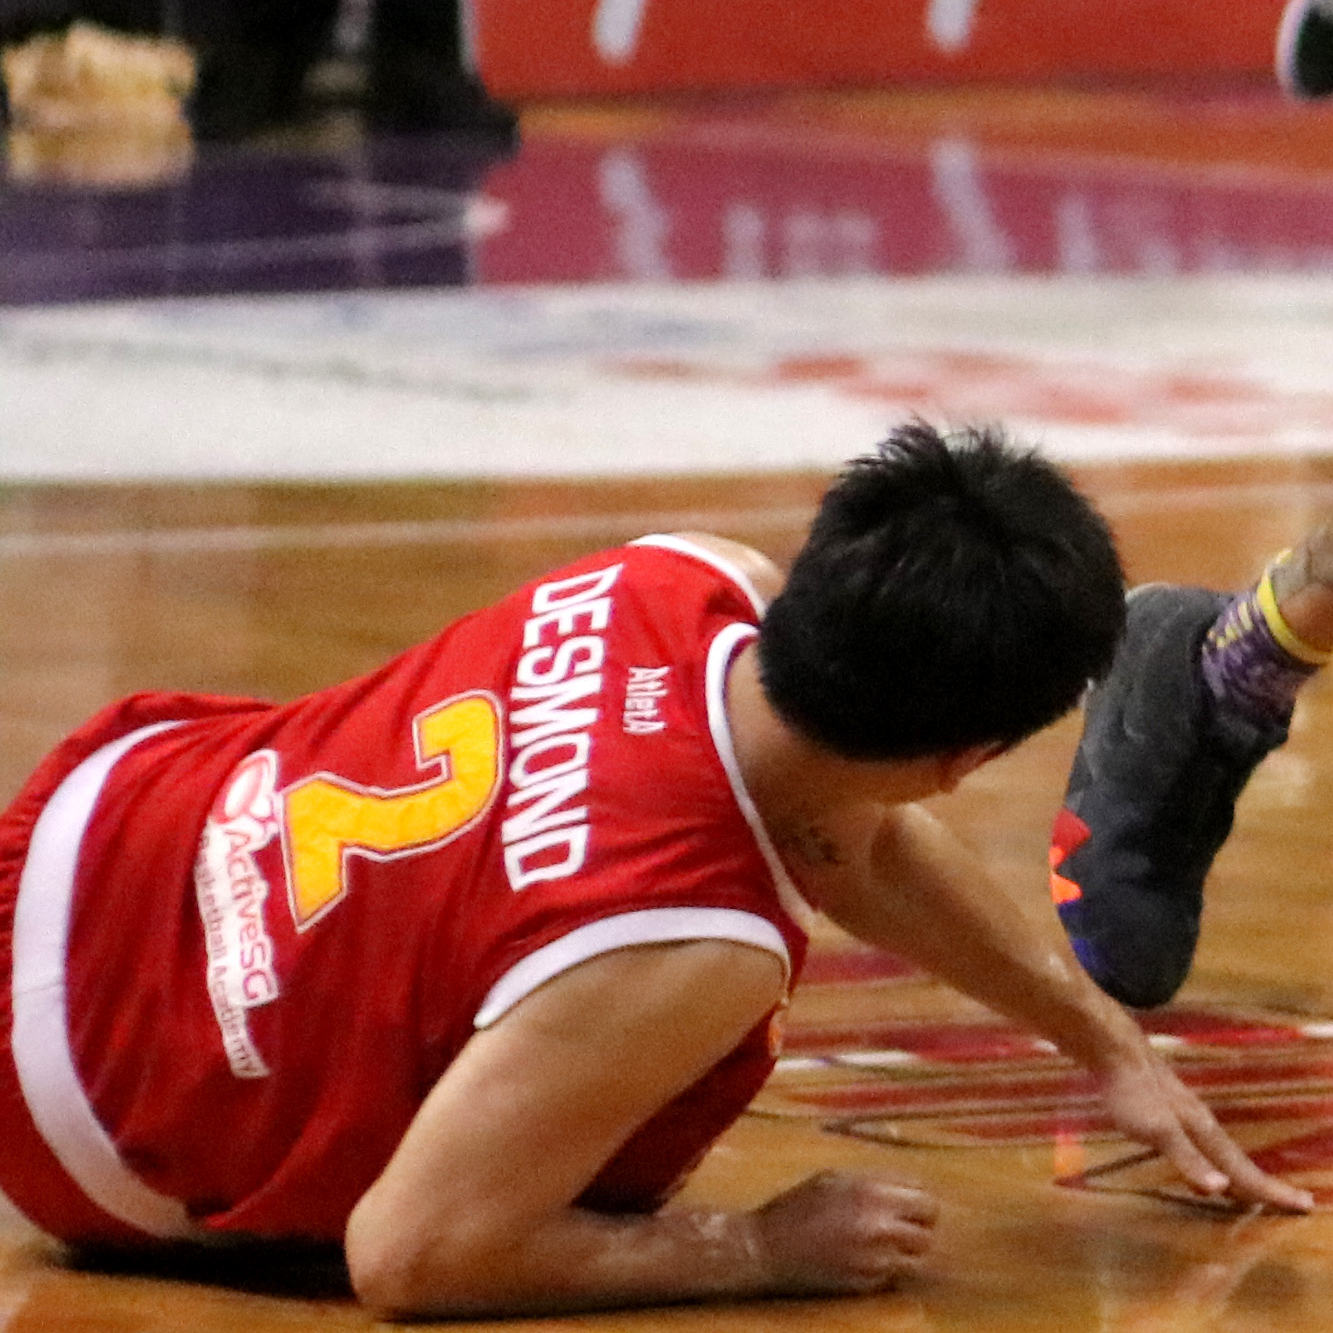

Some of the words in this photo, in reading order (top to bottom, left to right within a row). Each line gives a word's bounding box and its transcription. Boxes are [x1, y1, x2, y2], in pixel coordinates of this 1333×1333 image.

[280, 688, 503, 934] 2
[503, 563, 623, 892] DESMOND
[225, 827, 273, 1002] ActiveSG
